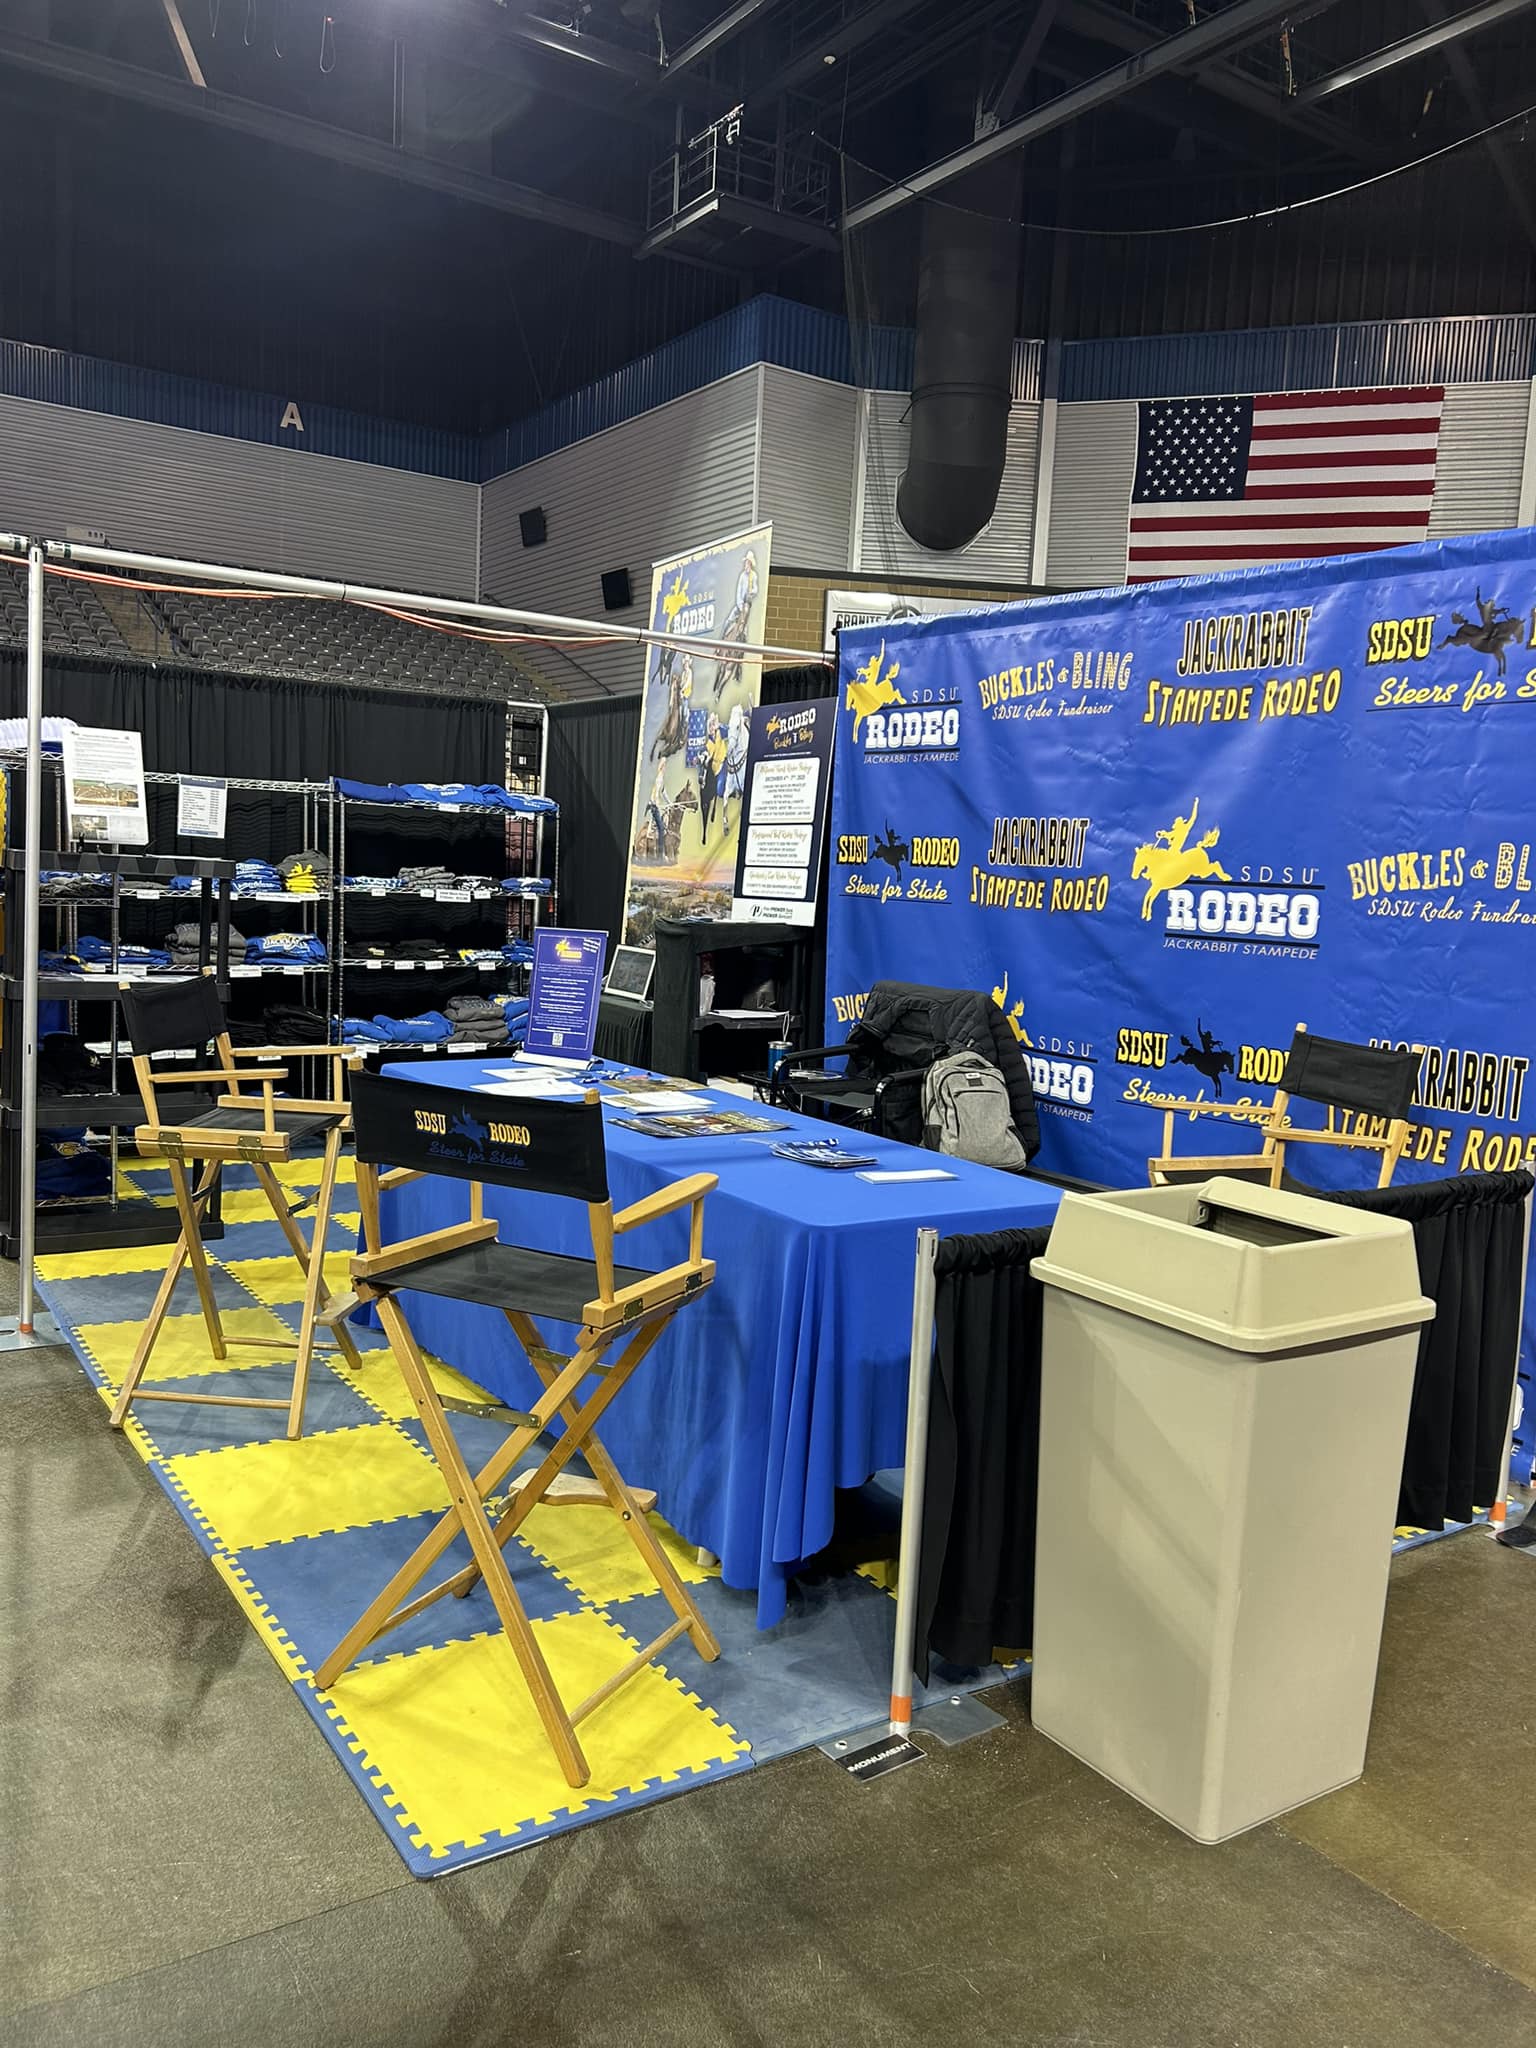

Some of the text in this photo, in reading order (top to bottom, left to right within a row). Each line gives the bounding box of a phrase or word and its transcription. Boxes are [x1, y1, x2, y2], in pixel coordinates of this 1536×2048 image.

[280, 401, 305, 431] A
[673, 604, 716, 635] RODEO
[1177, 606, 1313, 677] JACKRABBIT
[1365, 614, 1437, 667] SDSU
[911, 686, 958, 704] SDSU
[978, 651, 1134, 710] BUCKLES & BLING
[1143, 667, 1343, 727] STAMPEDE RODEO
[1373, 677, 1459, 706] Steers
[1461, 670, 1507, 713] for
[779, 708, 817, 734] RODEO
[992, 695, 1114, 721] SDSU Rodeo Fundraiser
[865, 708, 960, 749] RODEO
[864, 751, 960, 765] JACKRABBIT STAMPEDE
[837, 834, 868, 865] SDSU
[911, 835, 960, 868] RODEO
[987, 817, 1089, 868] JACKRABBIT
[1240, 865, 1317, 885] SDSU
[1347, 842, 1536, 900] BUCKLES & BL
[845, 874, 948, 904] Steers for State
[969, 865, 1110, 914] STAMPEDE RODEO
[1166, 889, 1320, 940] RODEO
[1368, 897, 1416, 918] SDSU
[1420, 896, 1464, 922] Rodeo
[1163, 938, 1318, 960] JACKRABBIT STAMPEDE
[1038, 1035, 1092, 1057] SDSU
[1115, 1027, 1290, 1086] SDSU ROD
[1022, 1053, 1095, 1104] DEO
[414, 1109, 531, 1146] SDSU RODEO
[1043, 1103, 1093, 1123] STAMPEDE
[466, 1146, 485, 1165] for
[489, 1150, 526, 1168] State
[1460, 1128, 1536, 1172] RODE
[847, 1741, 911, 1772] MONUMENT
